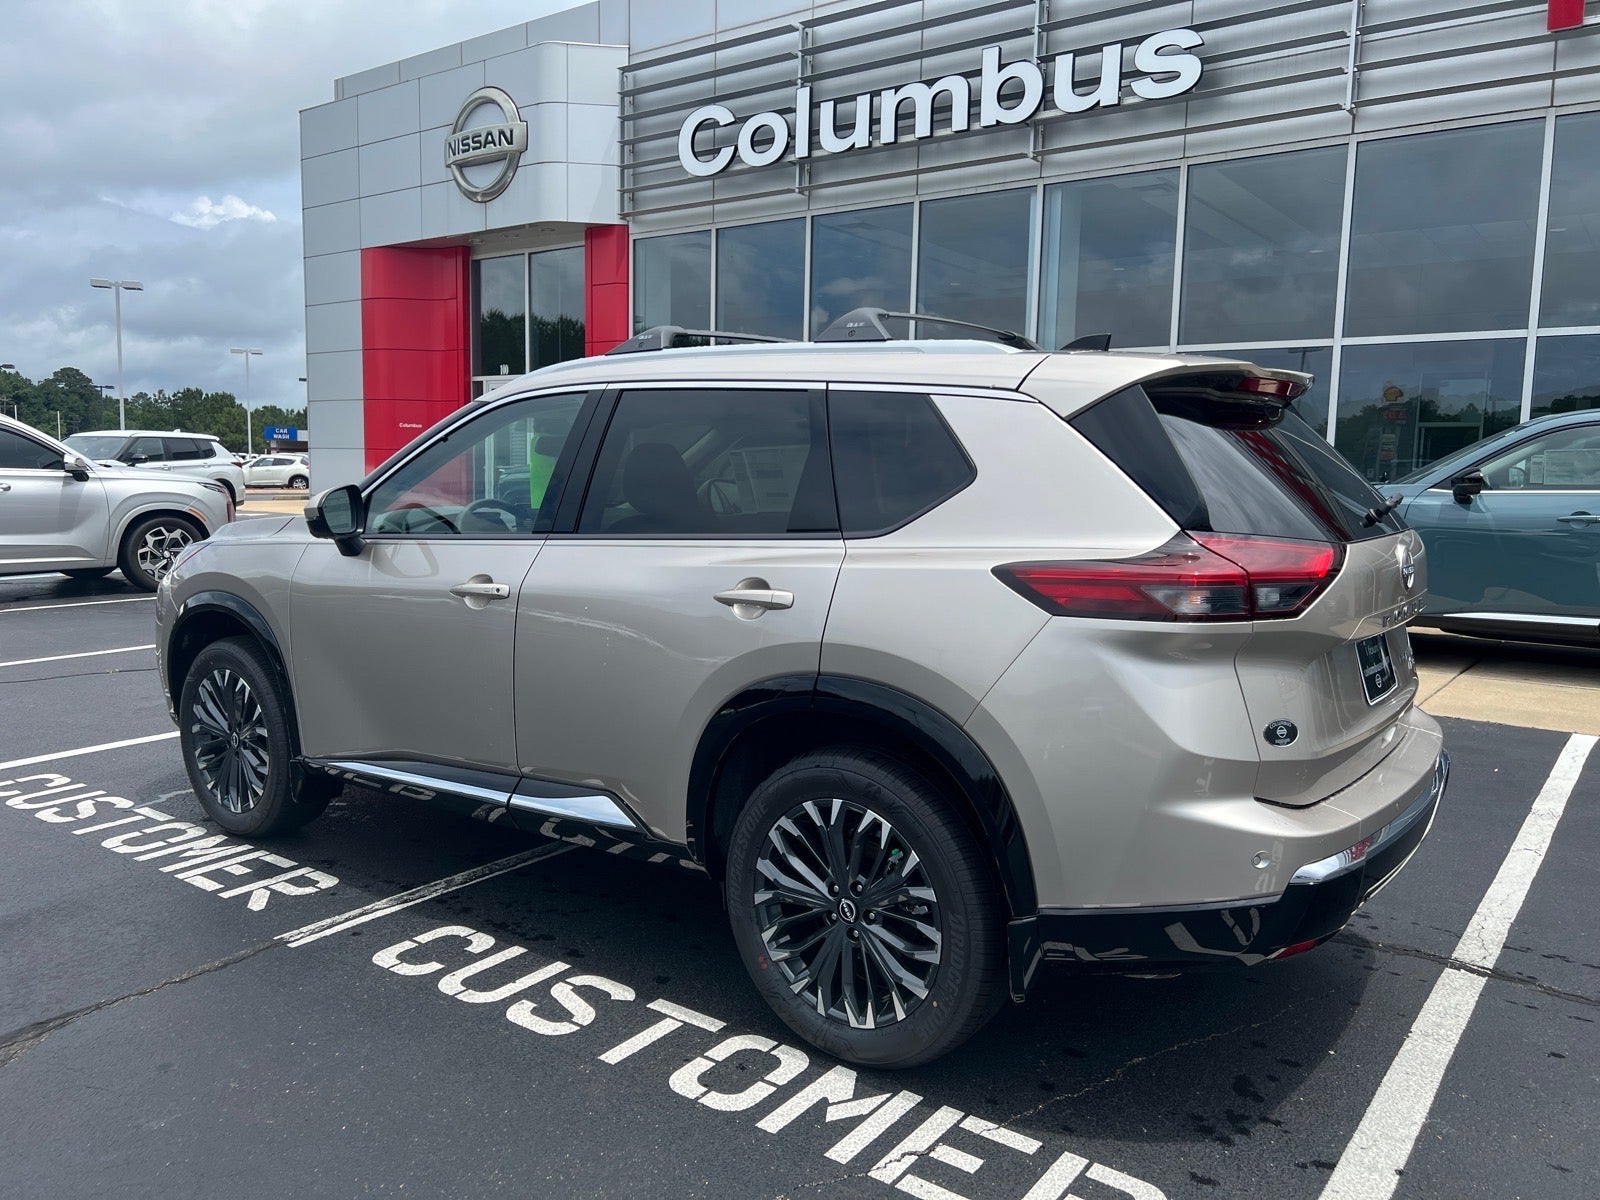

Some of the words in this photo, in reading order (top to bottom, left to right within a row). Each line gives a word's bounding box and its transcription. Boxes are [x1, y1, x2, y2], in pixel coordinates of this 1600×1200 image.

[447, 128, 514, 159] NISSAN
[677, 28, 1205, 177] Columbus
[500, 364, 509, 375] 100
[0, 774, 340, 911] CUSTOMER
